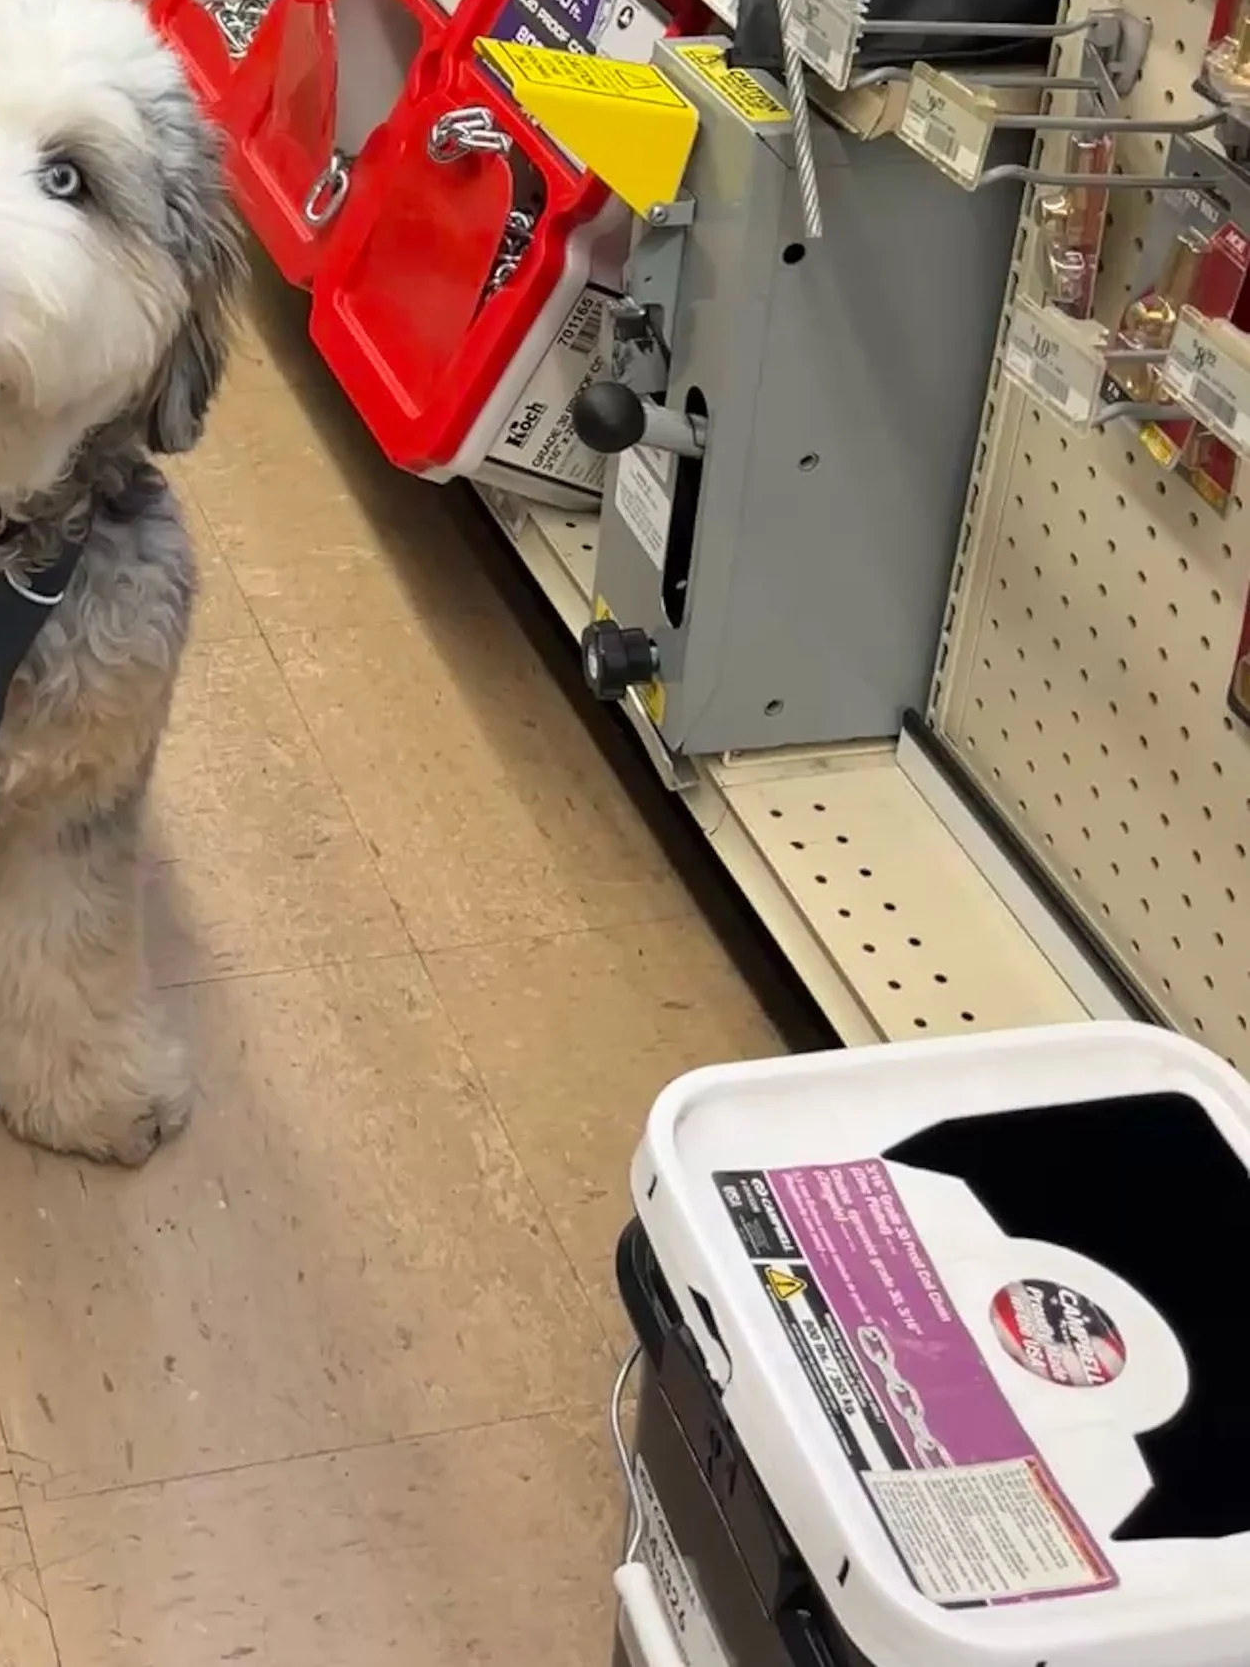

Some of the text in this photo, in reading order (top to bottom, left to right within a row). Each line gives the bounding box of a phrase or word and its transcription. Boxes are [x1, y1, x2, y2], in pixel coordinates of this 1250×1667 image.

[537, 7, 571, 42] PROOF
[505, 401, 543, 448] Koch
[532, 426, 562, 467] GRADE
[1057, 1285, 1107, 1388] CAMPBELL
